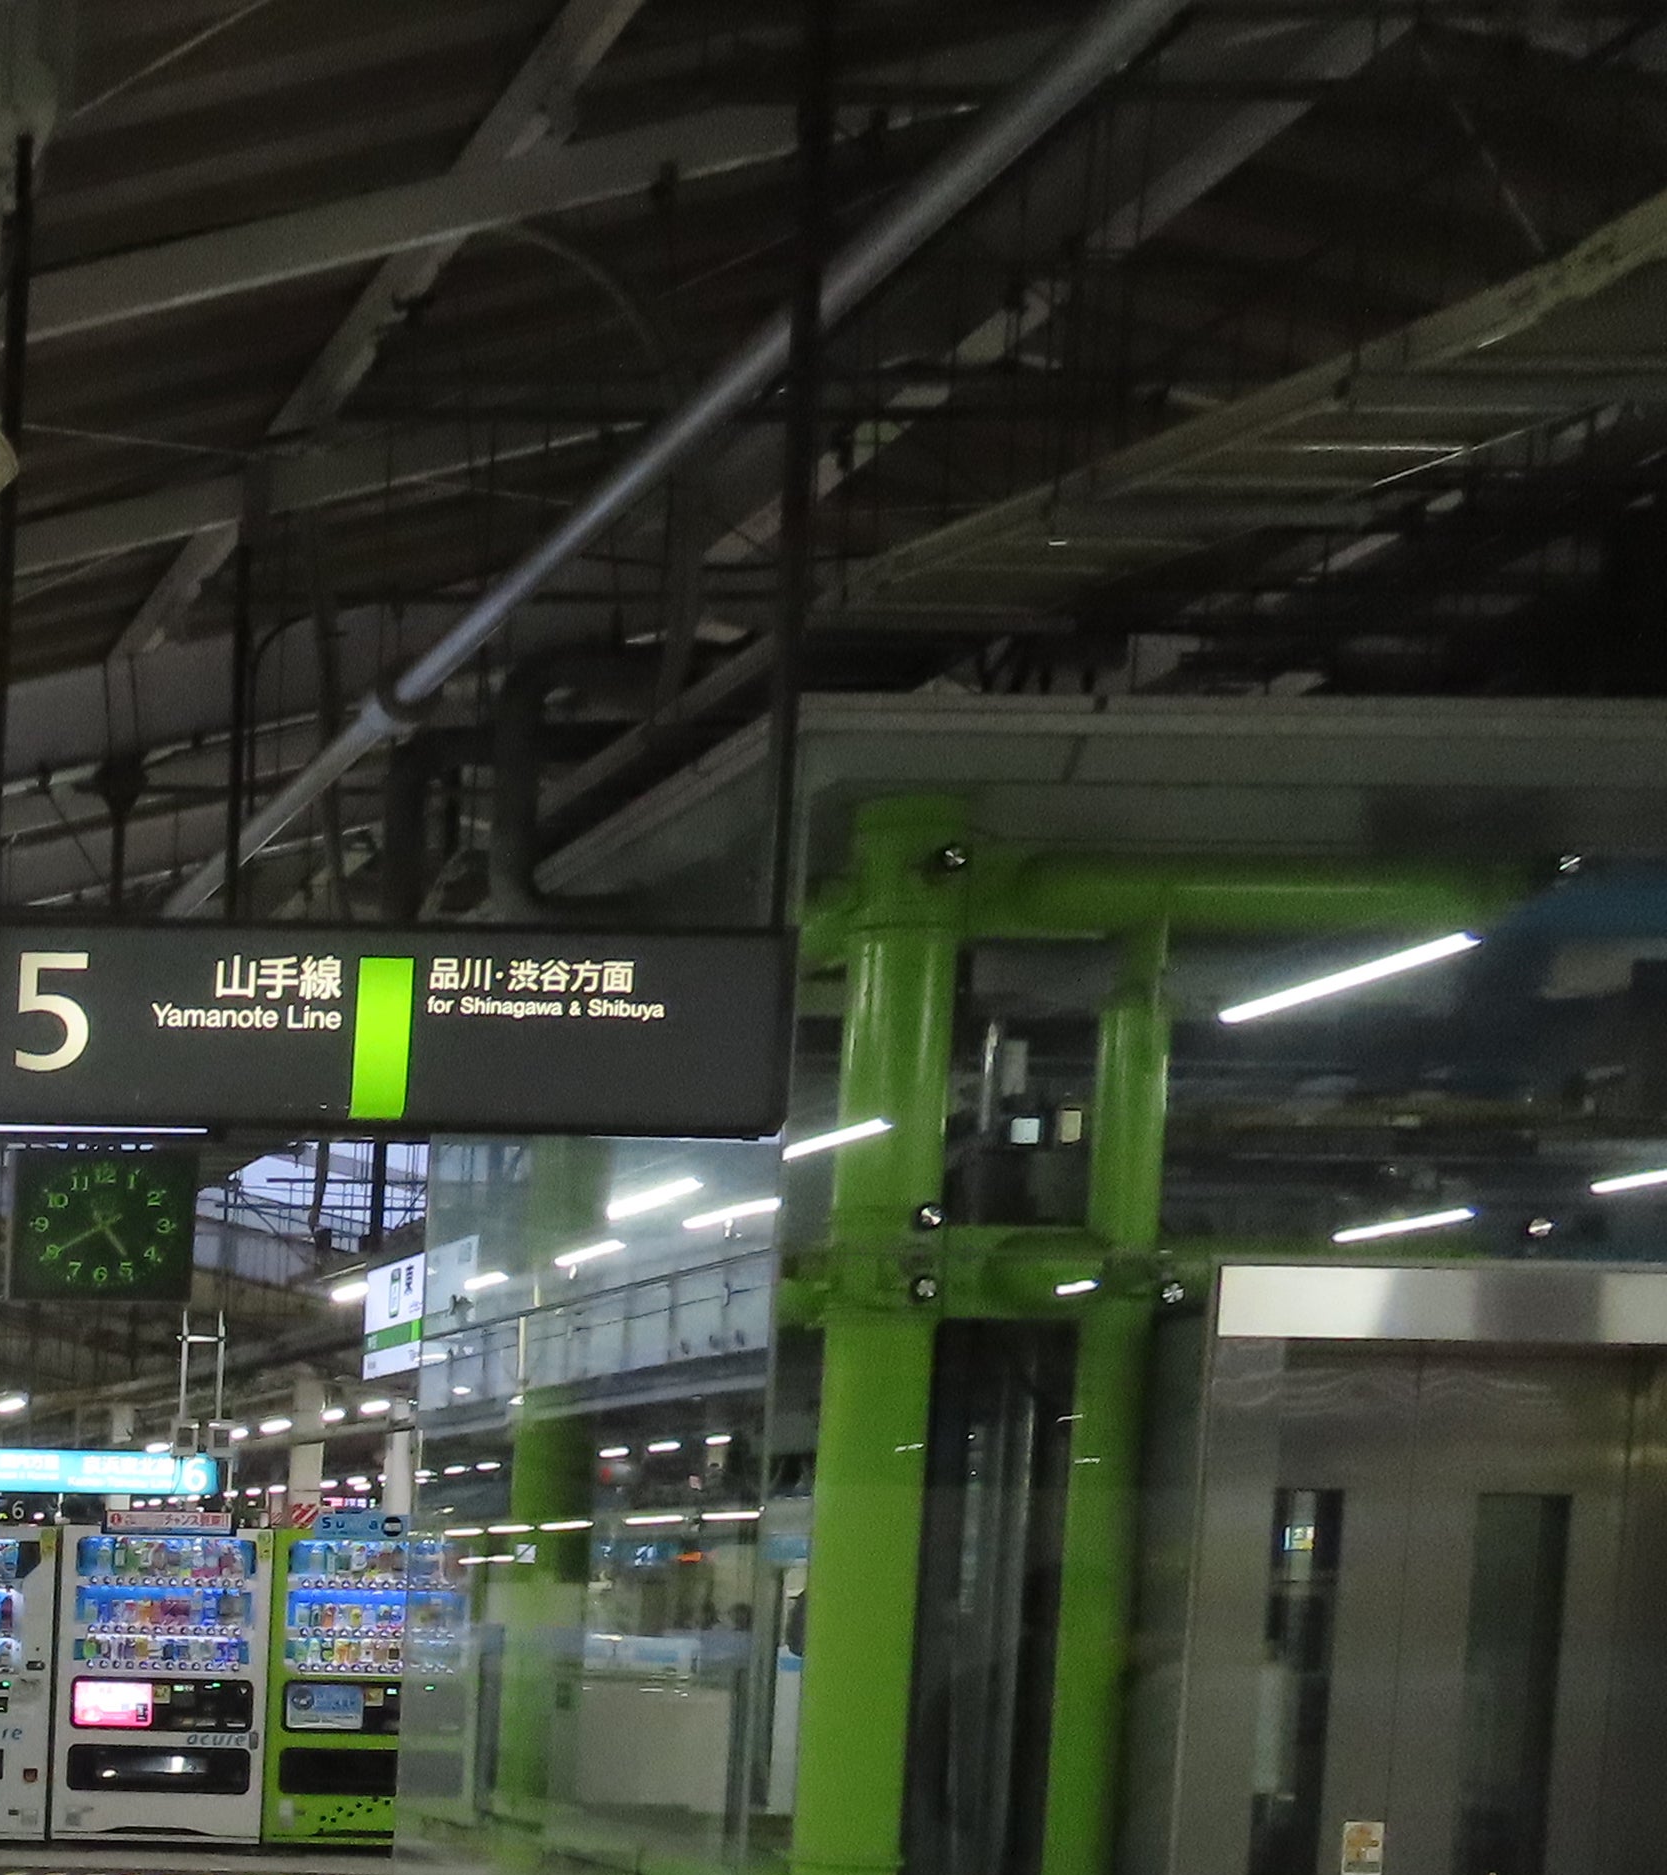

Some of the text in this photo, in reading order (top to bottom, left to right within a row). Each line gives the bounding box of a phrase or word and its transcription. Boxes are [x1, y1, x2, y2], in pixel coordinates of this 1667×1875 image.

[216, 955, 343, 1001] 山手線
[15, 951, 89, 1072] 5
[151, 1003, 342, 1030] Yamanote Line
[427, 996, 665, 1021] for Shinagawa & Shibuya
[95, 1165, 117, 1183] 12
[70, 1176, 89, 1191] 11
[47, 1193, 68, 1208] 10
[147, 1191, 162, 1207] 2
[34, 1216, 49, 1233] 9
[156, 1218, 170, 1234] 3
[143, 1246, 155, 1262] 4
[69, 1262, 82, 1278] 7
[93, 1266, 108, 1281] 6
[120, 1262, 133, 1277] 5
[183, 1457, 208, 1492] 6
[12, 1500, 25, 1520] 6
